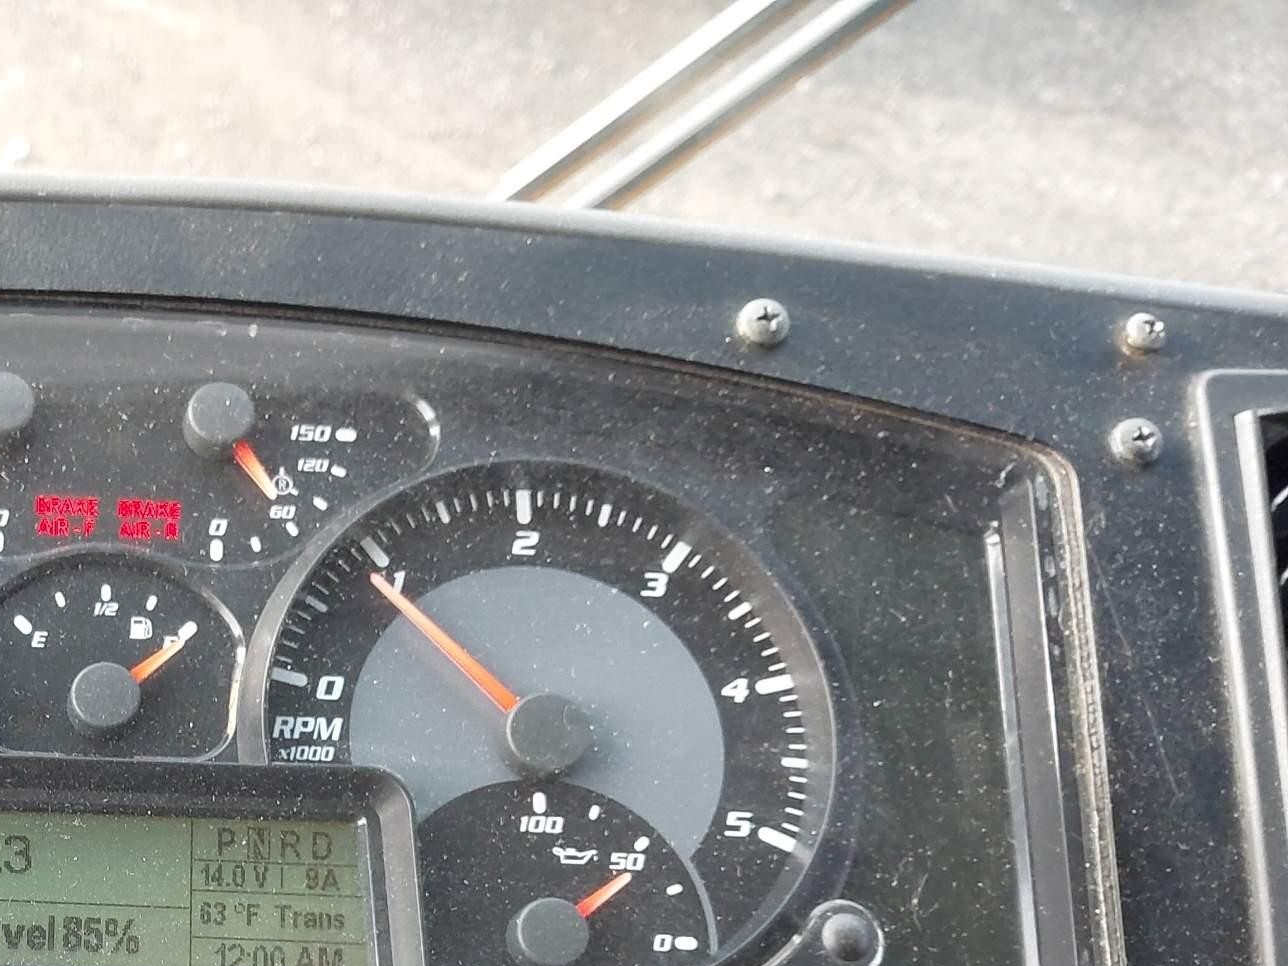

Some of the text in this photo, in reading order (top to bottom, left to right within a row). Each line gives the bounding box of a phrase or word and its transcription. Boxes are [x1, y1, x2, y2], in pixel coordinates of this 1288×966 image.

[290, 425, 332, 443] 150
[297, 457, 328, 473] 120
[269, 504, 296, 520] 60
[210, 519, 227, 536] 0
[512, 531, 539, 555] 2
[392, 572, 406, 591] 1
[640, 574, 669, 597] 3
[93, 602, 119, 616] 1/2
[31, 631, 48, 648] E
[316, 677, 343, 699] 0
[720, 679, 750, 702] 4
[273, 718, 343, 740] RPM
[278, 746, 334, 762] x1000
[520, 817, 564, 834] 100
[725, 813, 754, 837] 5
[217, 827, 332, 860] P N R D
[609, 854, 645, 871] 50
[200, 863, 245, 887] 14.0
[274, 905, 345, 930] Trans
[62, 916, 140, 954] 85%
[653, 936, 671, 952] 0
